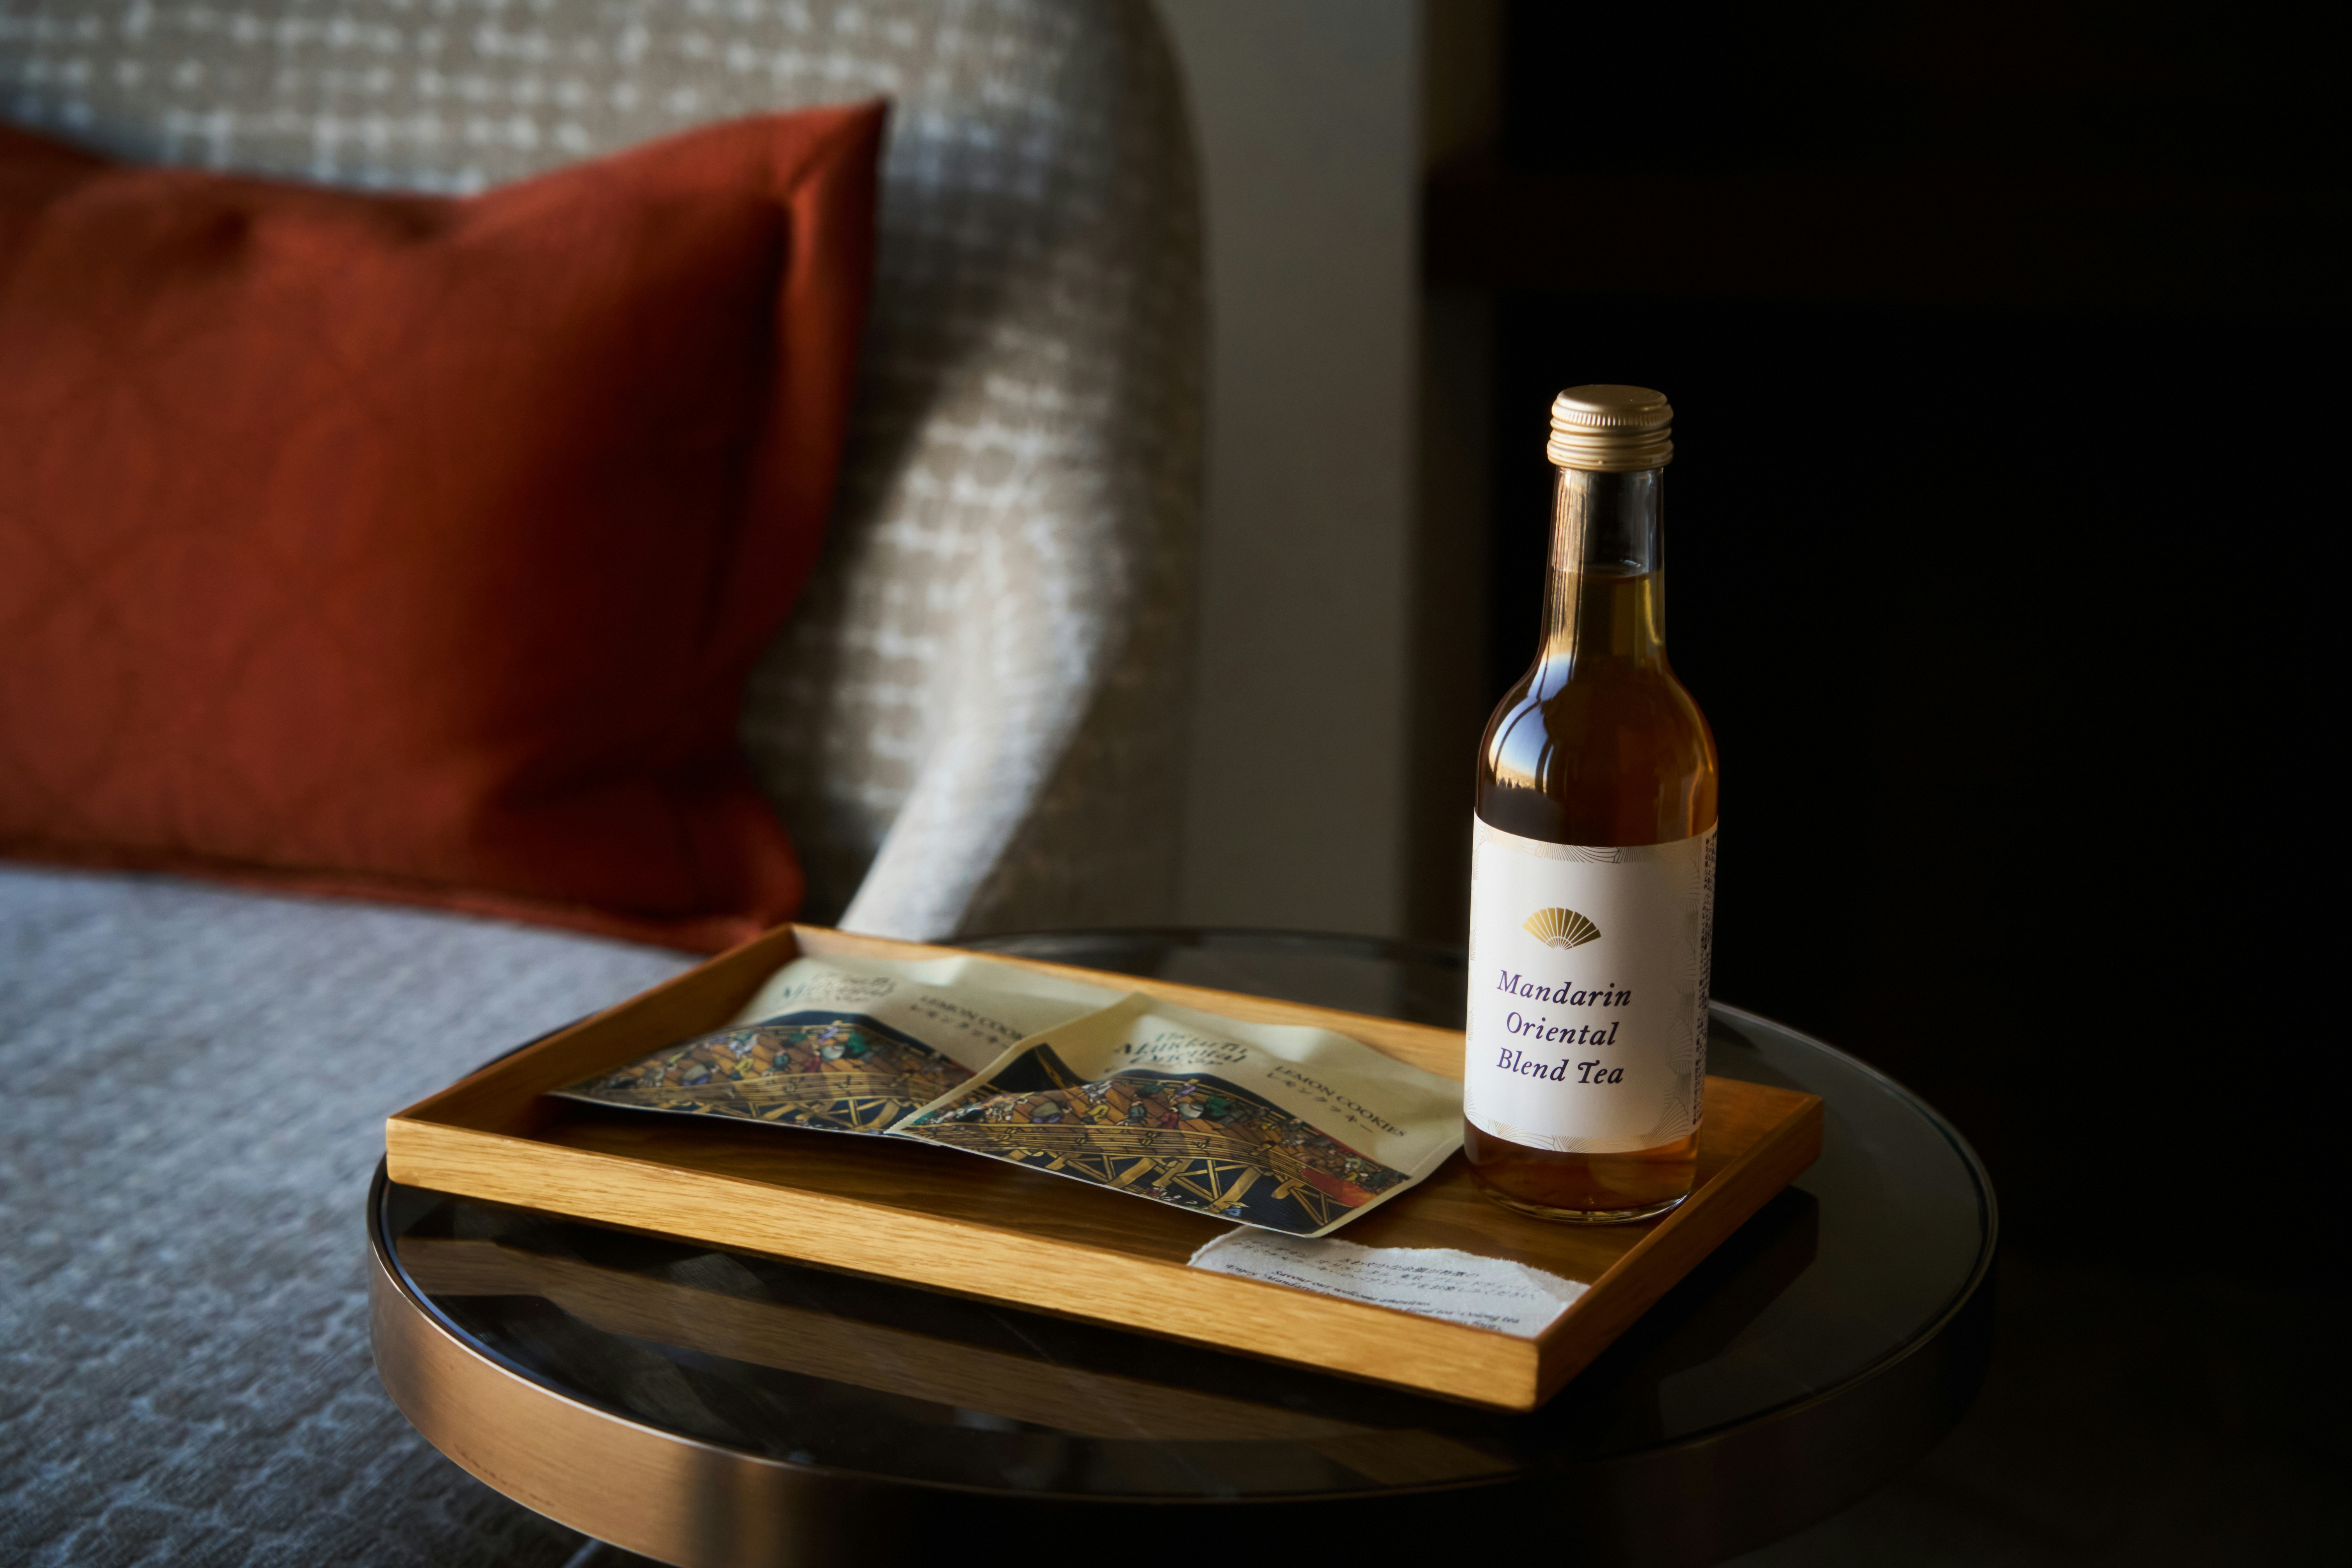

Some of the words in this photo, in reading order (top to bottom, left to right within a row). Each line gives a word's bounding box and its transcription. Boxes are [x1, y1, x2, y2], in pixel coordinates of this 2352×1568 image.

[1497, 969, 1631, 1007] Mandarin
[1507, 1012, 1619, 1045] Oriental
[1496, 1047, 1569, 1082] Blend
[1577, 1060, 1625, 1084] Tea
[1266, 1072, 1373, 1132] レモンクッキー
[1275, 1066, 1335, 1096] LEMON
[1336, 1096, 1406, 1136] COOKIES
[1271, 1270, 1312, 1282] Savour
[1334, 1288, 1379, 1301] welcome
